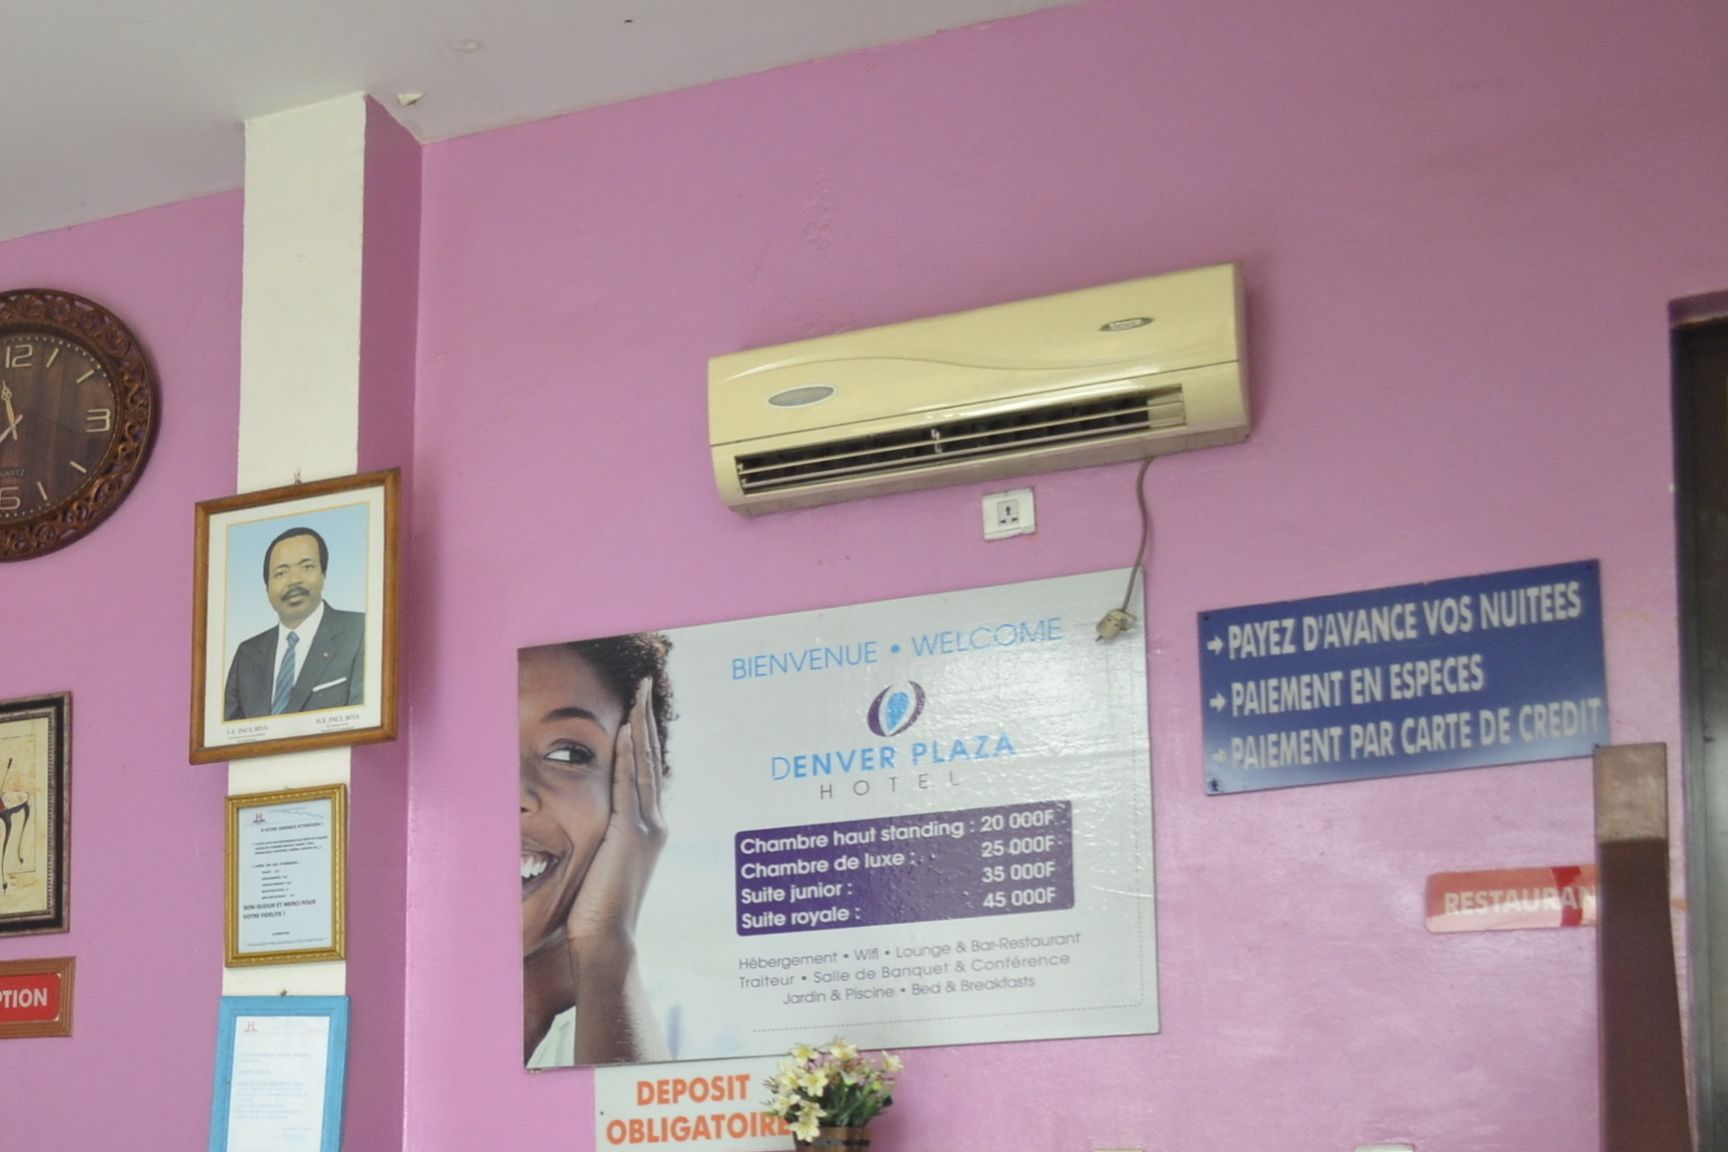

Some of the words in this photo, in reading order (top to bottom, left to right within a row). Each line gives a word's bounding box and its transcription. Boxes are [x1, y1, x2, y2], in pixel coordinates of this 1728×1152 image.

[6, 345, 33, 368] 12
[86, 408, 111, 432] 3
[1228, 618, 1296, 660] PAYEZ
[1302, 602, 1418, 652] D'AVANCE
[1423, 595, 1473, 636] VOS
[1480, 581, 1582, 630] NUITEES
[732, 641, 878, 680] BIENVENUE
[911, 617, 1063, 657] WELCOME
[1231, 671, 1344, 717] PAIEMENT
[1350, 666, 1383, 704] EN
[1389, 654, 1484, 700] ESPECES
[1231, 726, 1343, 770] PAIEMENT
[1350, 721, 1395, 760] PAR
[1401, 712, 1472, 755] CARTE
[1479, 708, 1511, 746] DE
[1519, 698, 1602, 742] CREDIT
[771, 746, 897, 781] DENVER
[912, 732, 1016, 766] PLAZA
[820, 771, 960, 799] HOTEL
[740, 834, 829, 854] Chambre
[833, 828, 877, 846] haut
[881, 820, 965, 842] standing
[980, 814, 1004, 833] 20
[1009, 809, 1055, 829] 000F
[741, 859, 829, 879] Chambre
[834, 855, 860, 871] de
[864, 853, 905, 869] luxe
[981, 840, 1004, 858] 25
[1009, 835, 1055, 855] 000F
[741, 886, 786, 904] Suite
[790, 882, 843, 903] junior
[981, 866, 1005, 883] 35
[1010, 861, 1056, 881] 000F
[741, 911, 786, 929] Suite
[791, 906, 850, 926] royale
[982, 891, 1007, 908] 45
[1011, 887, 1057, 906] 000F
[738, 952, 838, 970] Hébergement
[895, 943, 951, 959] Lounge
[955, 941, 967, 954] &
[971, 932, 1081, 951] Bar-Restaurant
[739, 975, 795, 989] Traiteur
[813, 971, 850, 984] Salle
[855, 969, 876, 981] de
[881, 962, 949, 979] Banquet
[954, 960, 966, 973] &
[971, 954, 1070, 972] Conférence
[783, 991, 826, 1005] Jardin
[830, 989, 841, 1002] &
[845, 987, 895, 1000] Piscine
[911, 982, 941, 996] Bed
[945, 980, 956, 993] &
[960, 976, 1036, 992] Breakfasts
[636, 1074, 751, 1106] DEPOSIT
[606, 1111, 793, 1145] OBLIGATOIRE
